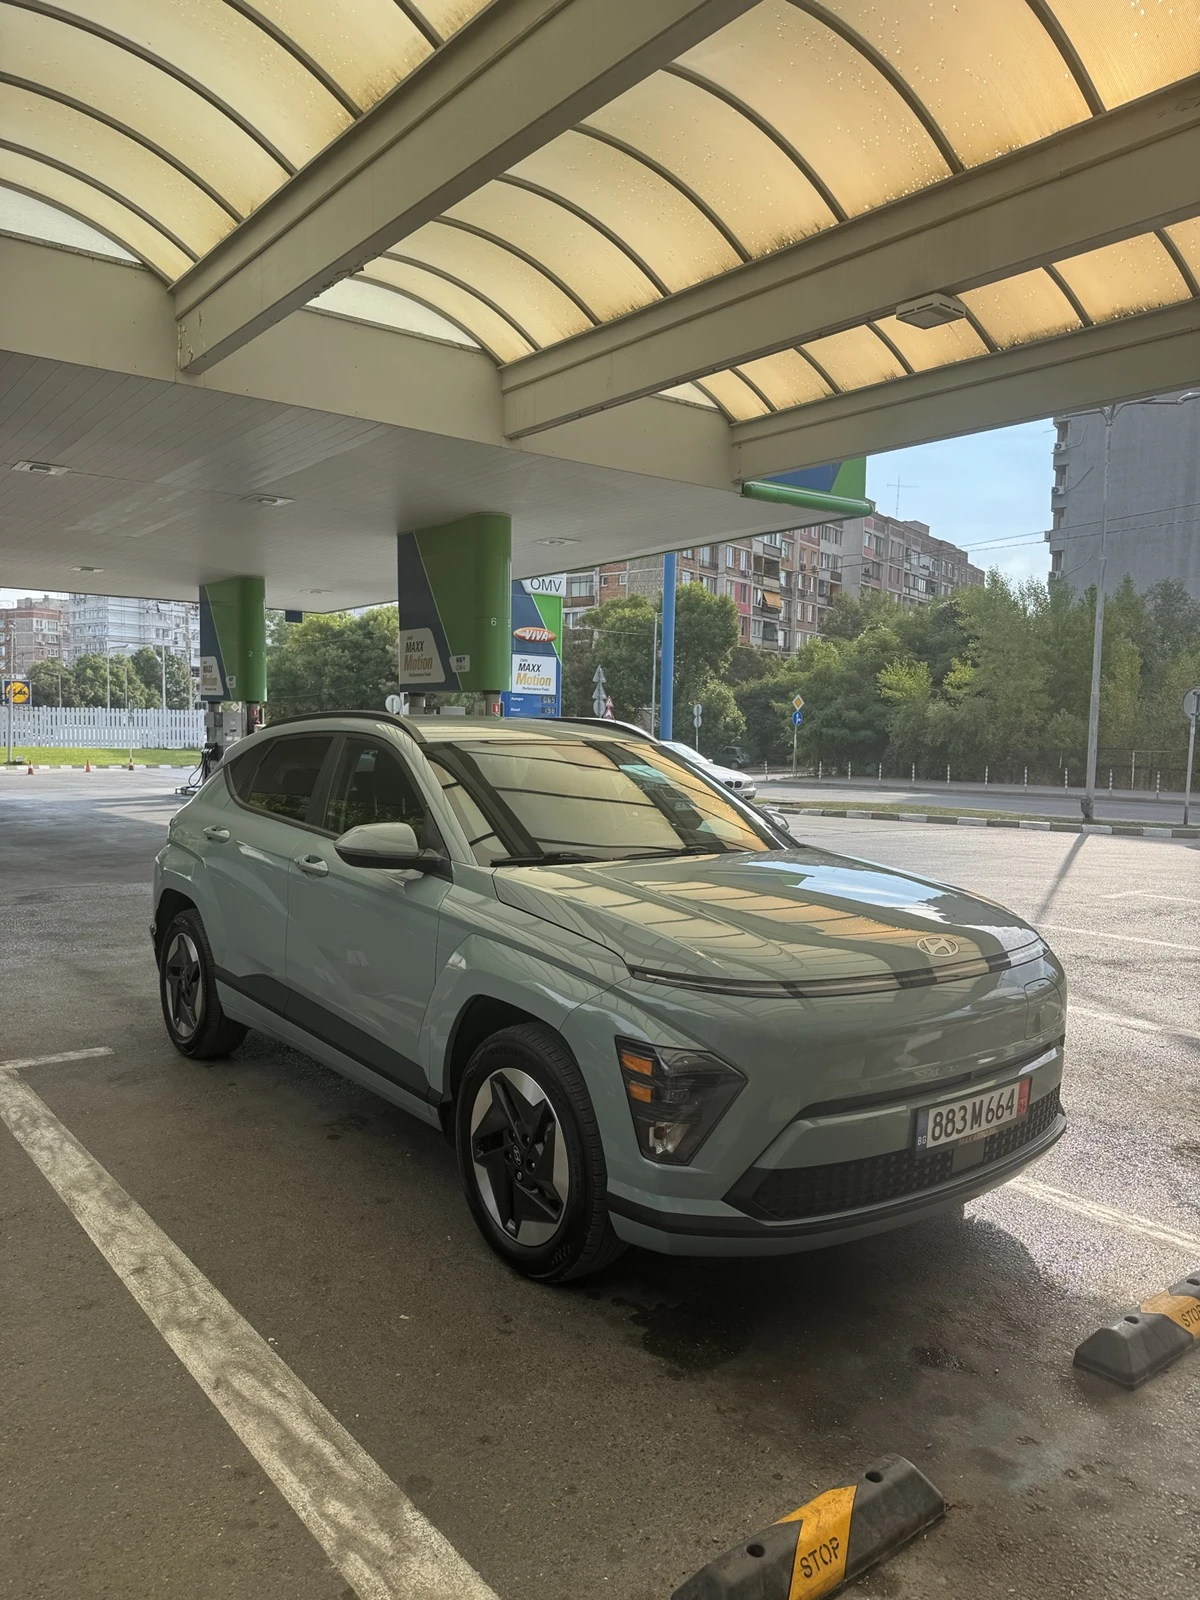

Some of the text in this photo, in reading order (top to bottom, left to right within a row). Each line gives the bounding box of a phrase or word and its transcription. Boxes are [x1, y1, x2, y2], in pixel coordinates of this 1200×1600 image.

[530, 578, 562, 592] OMV
[491, 617, 497, 626] 6
[525, 629, 548, 642] VIVA
[405, 640, 424, 653] MAXX
[404, 654, 433, 671] Motion
[518, 663, 541, 672] MAXX
[516, 672, 551, 686] Motion
[917, 1135, 927, 1146] BG
[800, 1536, 840, 1578] STOP
